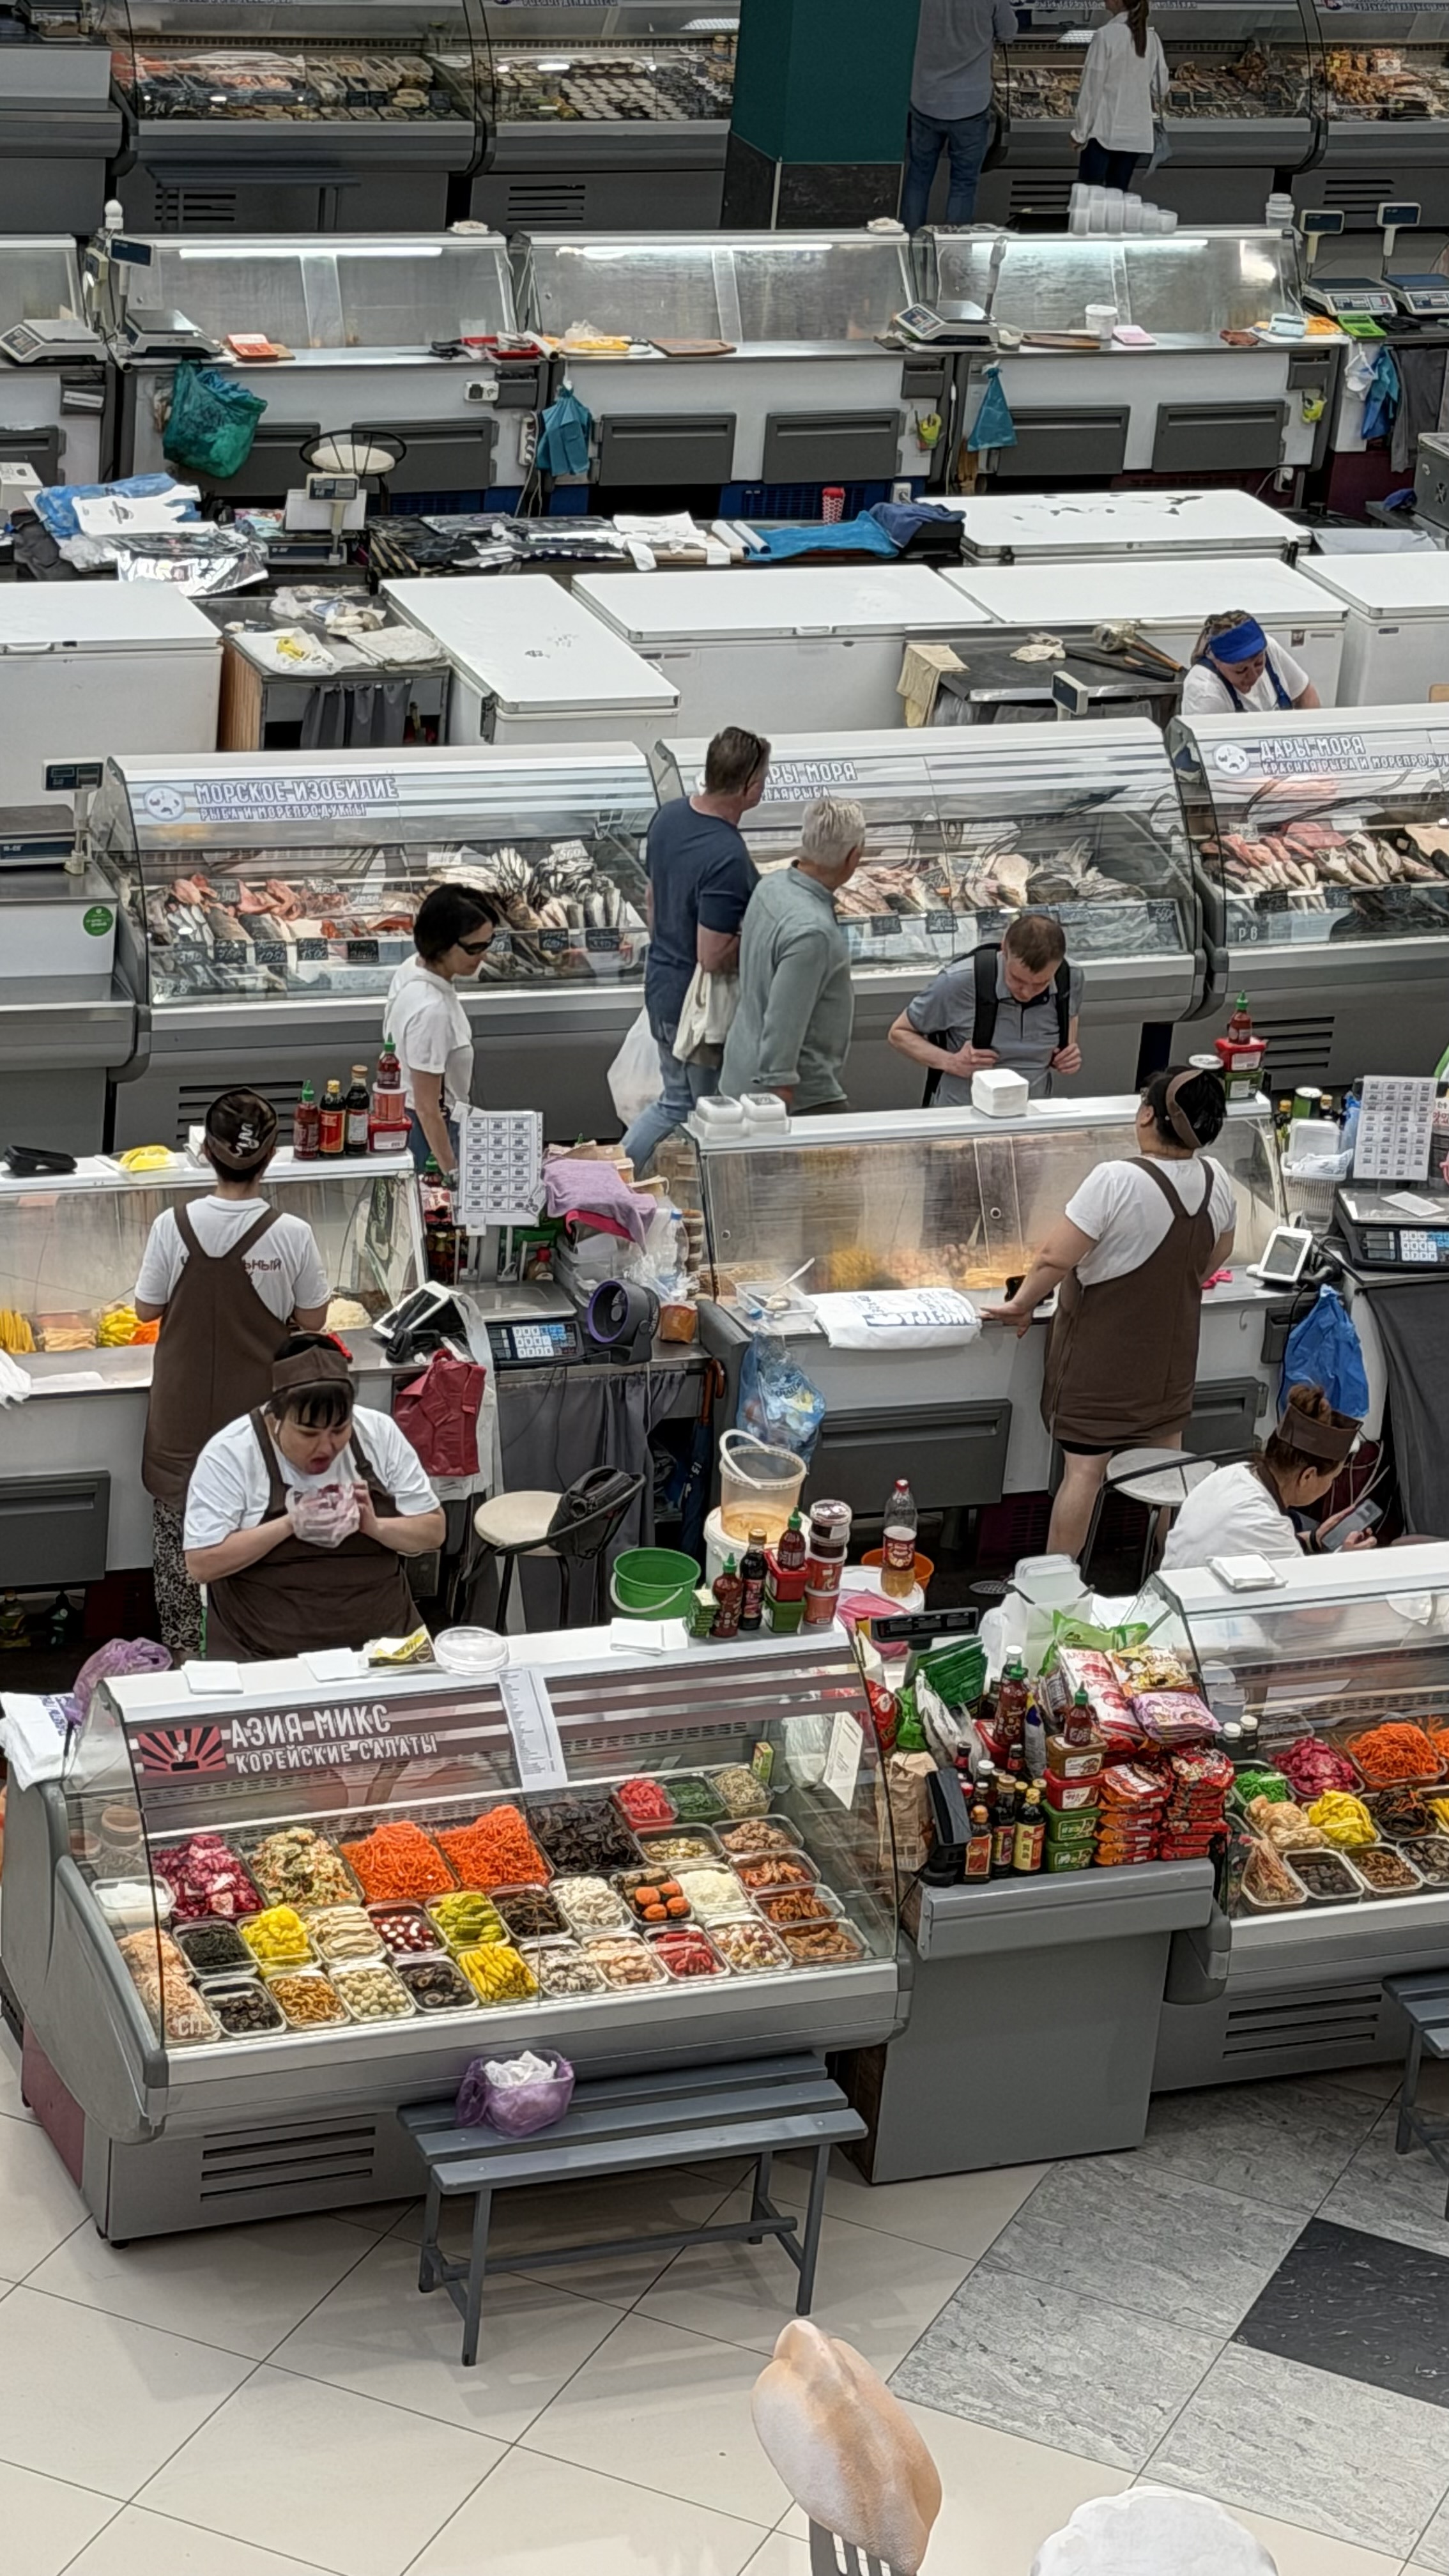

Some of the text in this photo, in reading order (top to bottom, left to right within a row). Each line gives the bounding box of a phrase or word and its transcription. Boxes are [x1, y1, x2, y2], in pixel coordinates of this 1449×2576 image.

[1259, 735, 1366, 761] ДАРЫ МОРЯ
[765, 762, 858, 785] РЫ МОРЯ
[1261, 760, 1317, 775] КРАСНАЯ
[1321, 758, 1358, 772] РЫБА
[1358, 756, 1369, 769] И
[194, 777, 399, 804] МОРСКОЕ ИЗОБИЛИЕ
[793, 785, 831, 799] РЫБА
[199, 803, 367, 821] РЫБА И МОРЕПРОДУКТЫ
[234, 1733, 438, 1774] КОРЕЙСКИЕ САЛАТЫ
